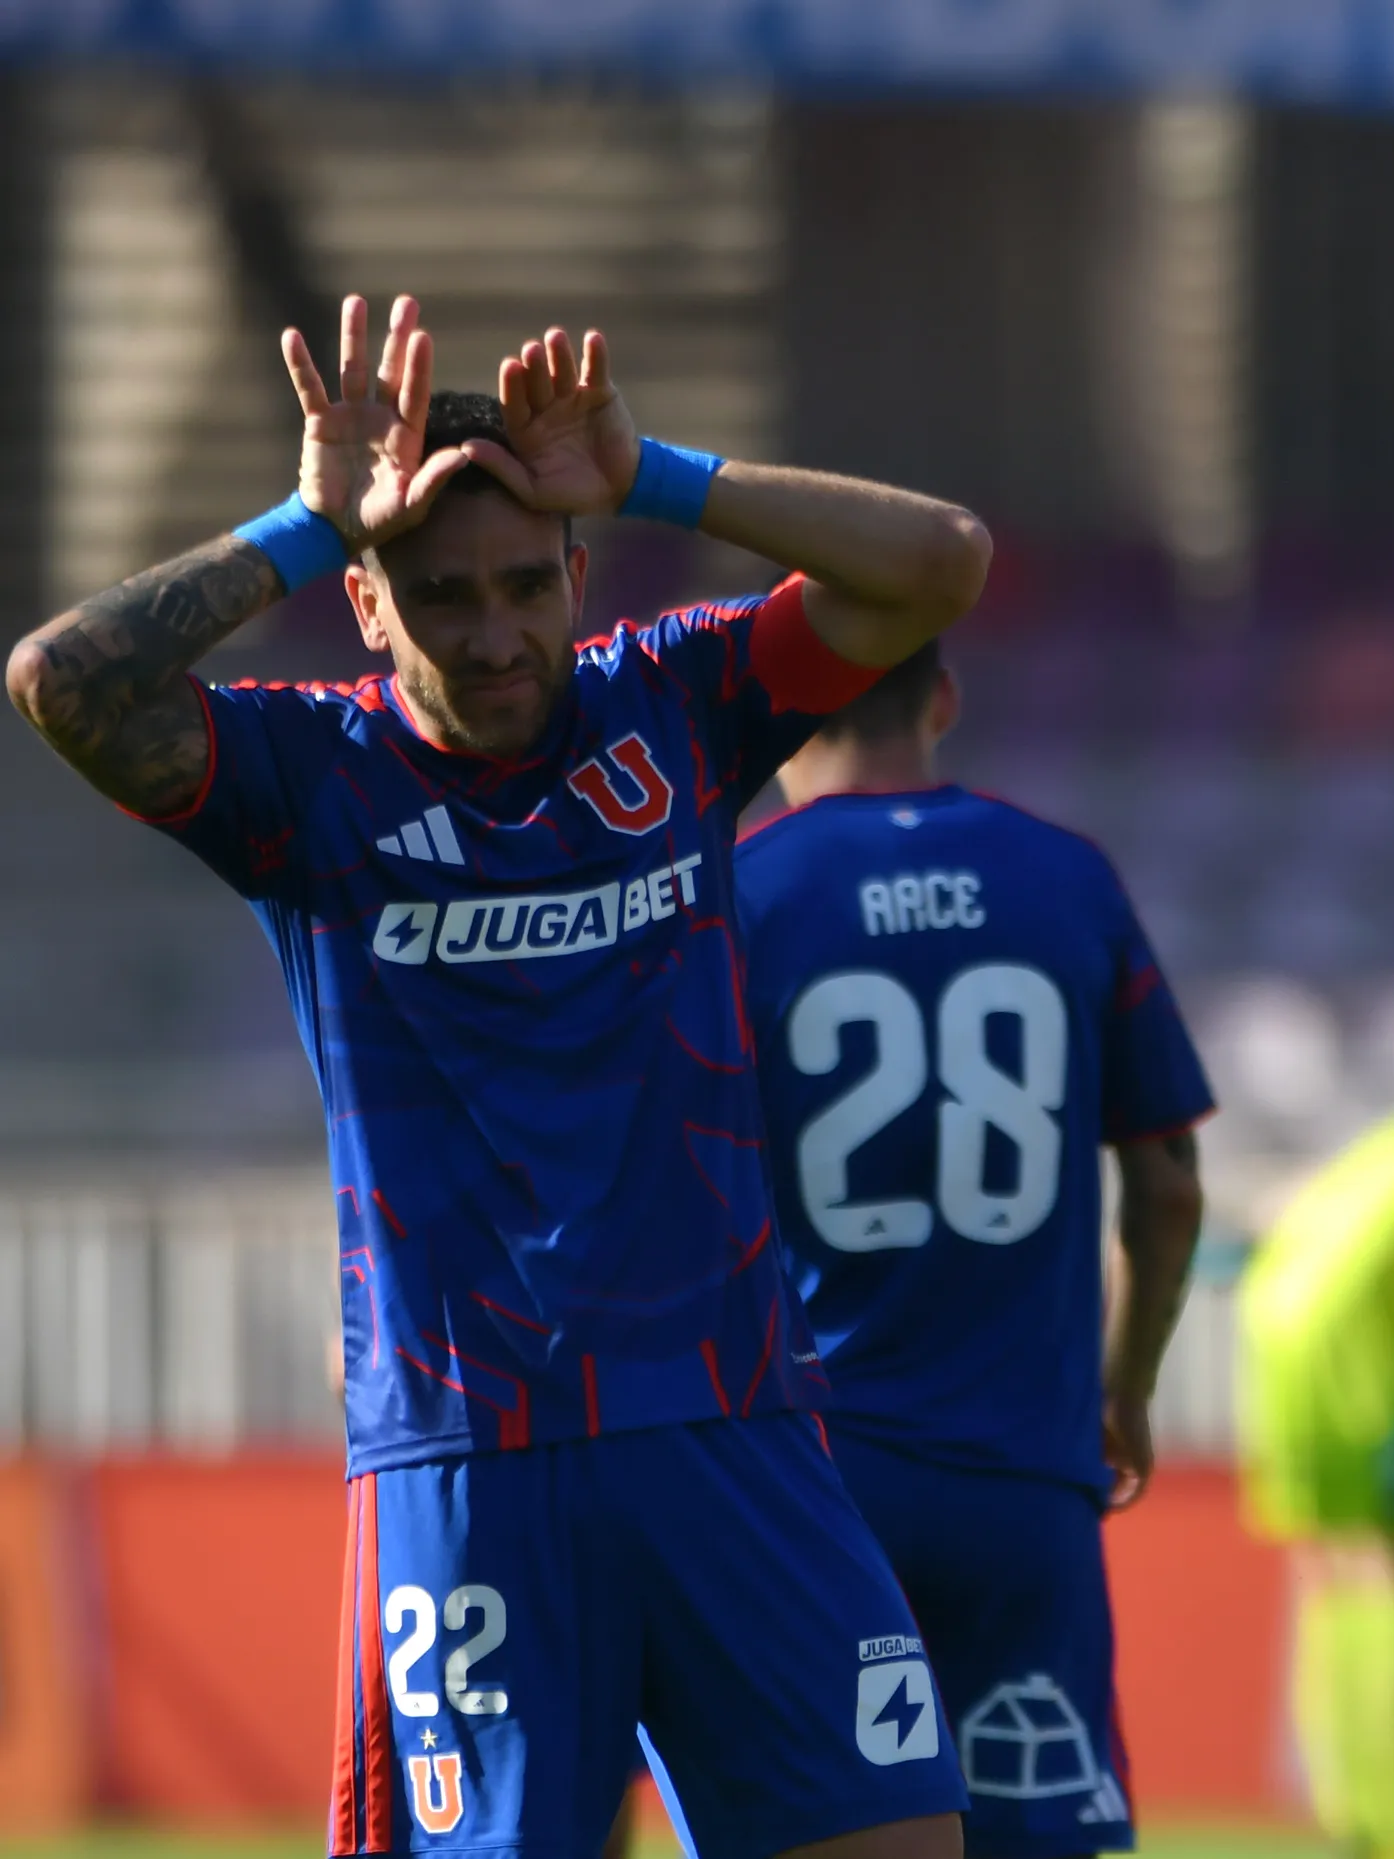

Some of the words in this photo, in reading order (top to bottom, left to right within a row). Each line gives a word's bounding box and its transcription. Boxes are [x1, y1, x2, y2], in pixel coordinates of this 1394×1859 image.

[567, 732, 673, 836] U
[859, 869, 987, 936] ARCE
[788, 963, 1067, 1252] 28
[385, 1585, 508, 1717] 22
[408, 1753, 464, 1834] U
